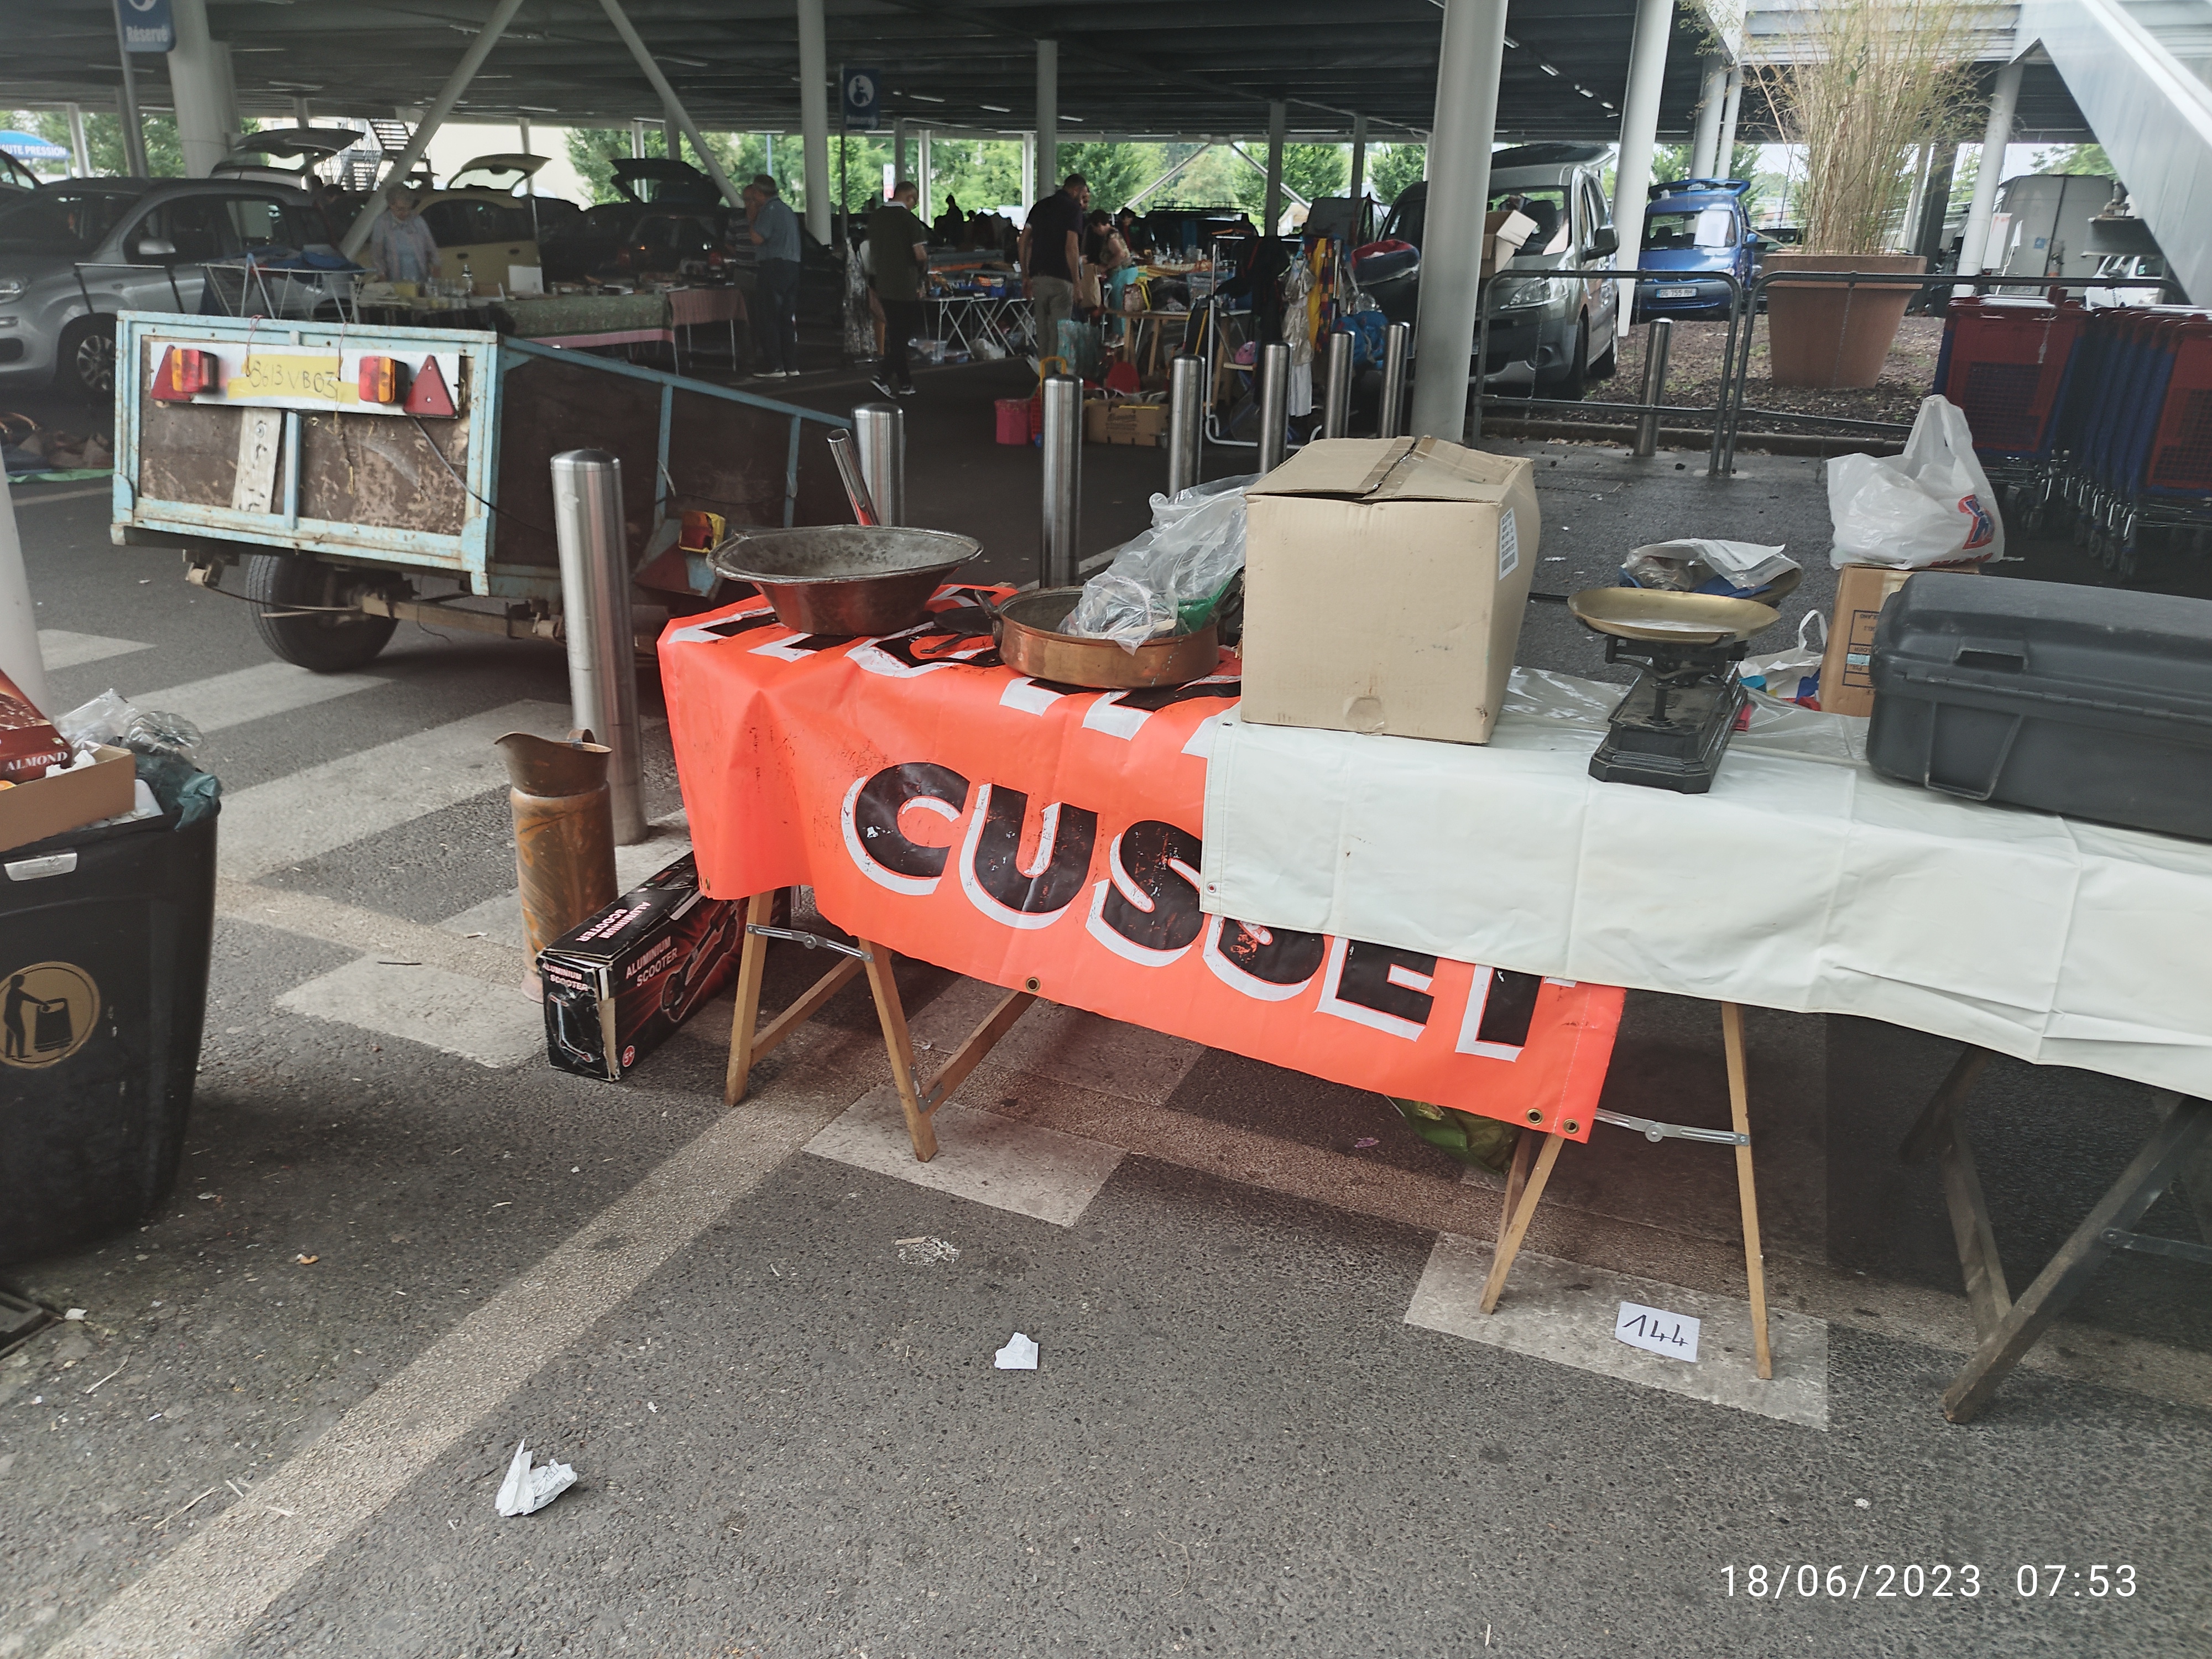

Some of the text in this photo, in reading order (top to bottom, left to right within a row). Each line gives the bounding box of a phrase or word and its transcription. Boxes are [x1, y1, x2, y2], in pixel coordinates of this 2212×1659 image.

[0, 144, 66, 156] AUTE PRESSION
[6, 752, 68, 771] ALMOND
[575, 909, 628, 942] SCOOTER
[598, 901, 651, 939] ALUMINIUM
[625, 936, 672, 980] ALUMINIUM
[637, 947, 678, 987] SCOOTER
[542, 962, 582, 981] ALUMINIUM
[550, 974, 589, 992] SCOOTER
[624, 1050, 635, 1063] 5+
[1621, 1314, 1689, 1347] 144
